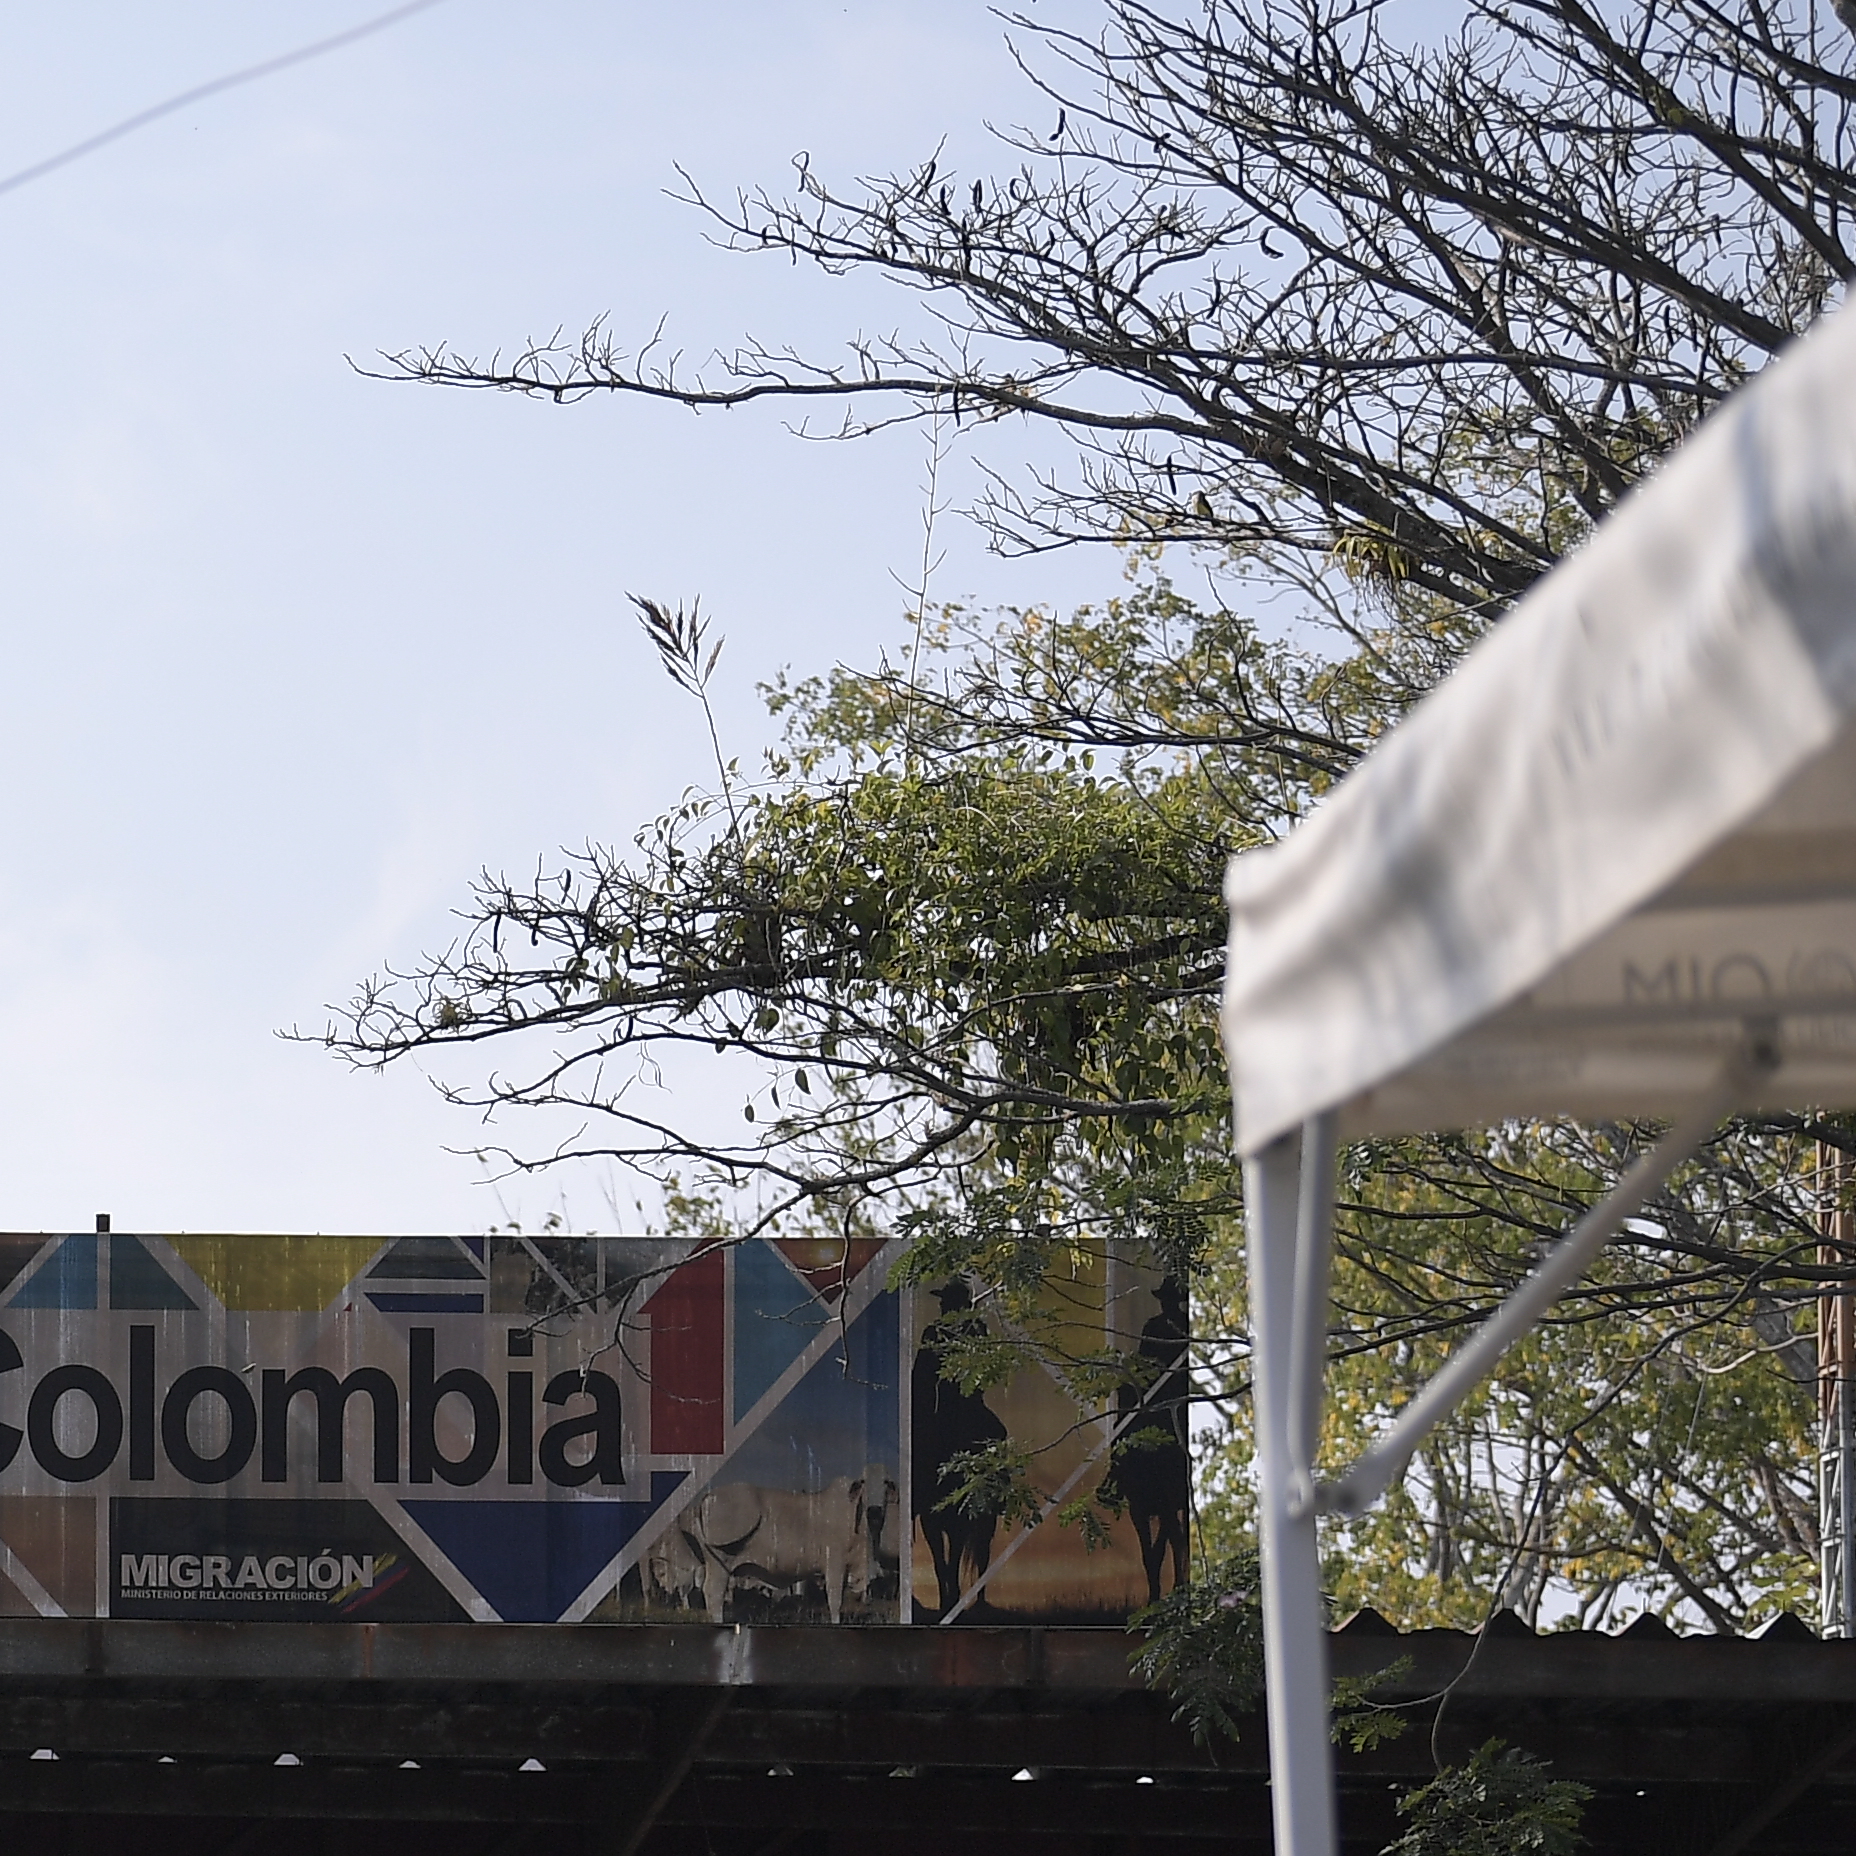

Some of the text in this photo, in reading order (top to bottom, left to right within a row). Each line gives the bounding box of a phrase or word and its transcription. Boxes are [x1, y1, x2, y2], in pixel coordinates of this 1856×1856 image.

[121, 1548, 374, 1589] MIGRACIÓN
[121, 1590, 328, 1601] MINISTERIO DE RELACIONES EXTERIORES
